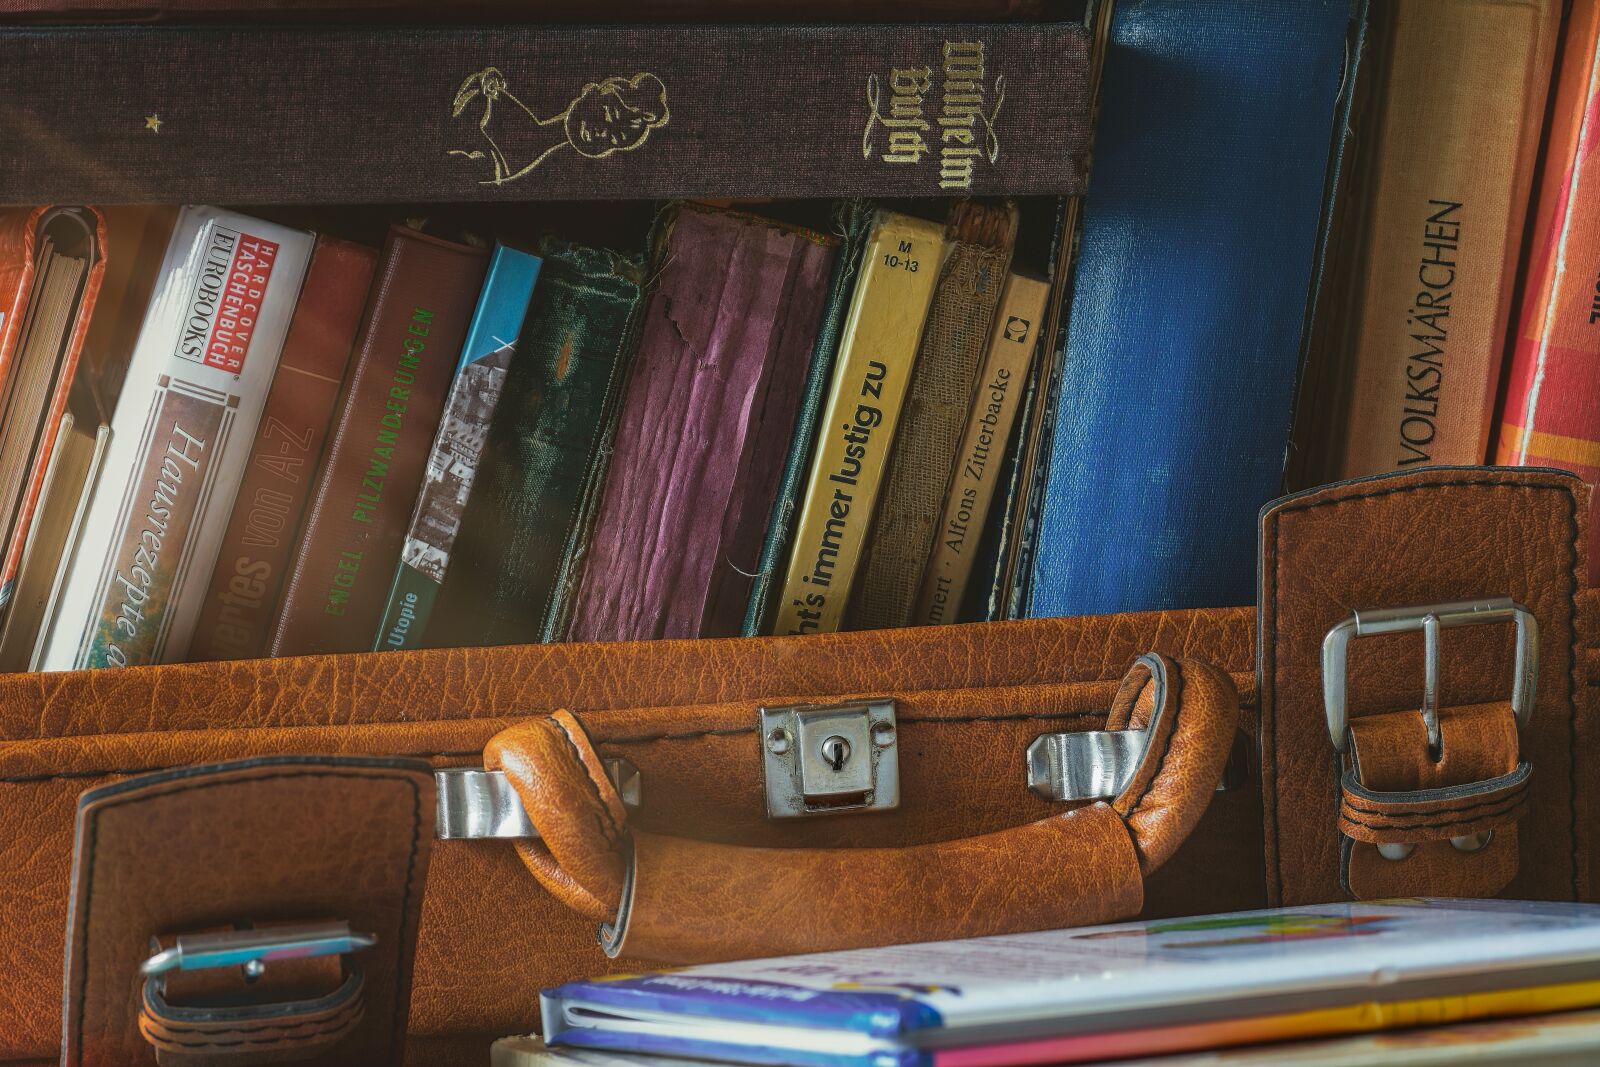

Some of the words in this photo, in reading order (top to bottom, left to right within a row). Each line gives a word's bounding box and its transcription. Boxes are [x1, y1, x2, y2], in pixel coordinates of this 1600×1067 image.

[937, 40, 986, 189] Wilhelm
[181, 232, 235, 359] EUROBOOKS
[208, 241, 259, 367] TASCHENBUCH
[882, 254, 920, 272] 10-13
[898, 240, 912, 253] M
[1397, 200, 1463, 466] VOLKSMÄRCHEN
[254, 416, 314, 484] A-Z
[324, 551, 363, 617] ENGEL
[352, 307, 435, 524] PILZWANDERUNGEN
[802, 488, 853, 586] immer
[830, 404, 882, 486] lustig
[860, 359, 887, 399] zu
[926, 575, 952, 626] mert
[945, 487, 977, 555] Alfons
[963, 366, 1011, 482] Zitterbacke
[115, 421, 205, 638] Hausrezepte
[242, 487, 294, 550] von
[387, 590, 418, 647] Utopie
